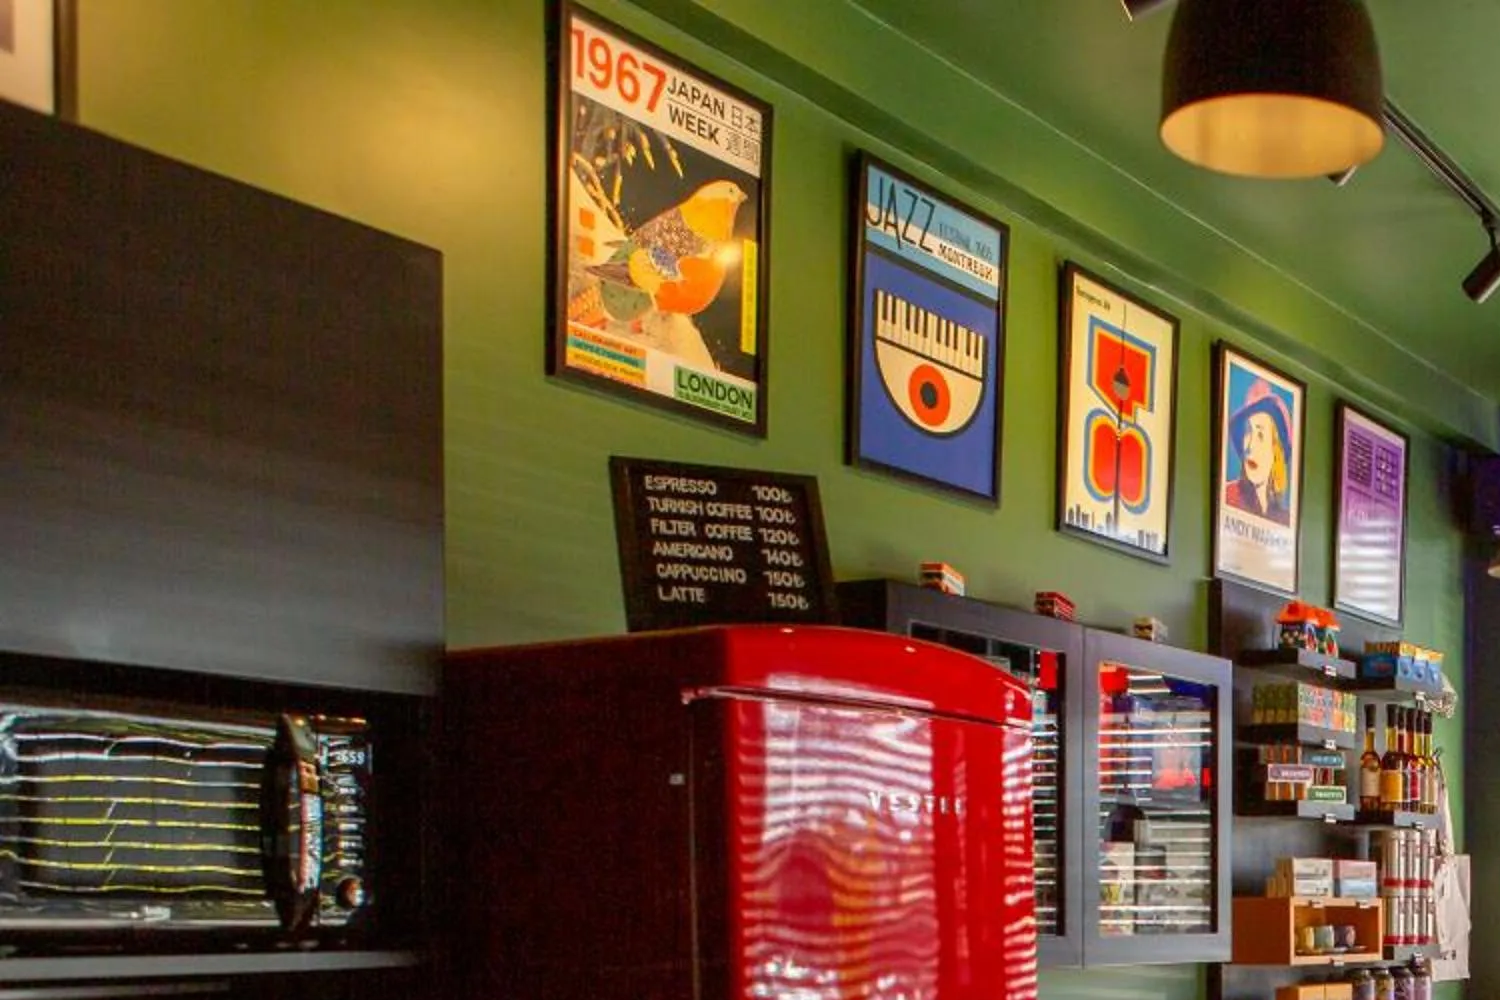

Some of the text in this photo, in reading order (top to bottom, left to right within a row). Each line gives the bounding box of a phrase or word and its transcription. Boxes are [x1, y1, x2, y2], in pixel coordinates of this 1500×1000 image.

[572, 29, 666, 113] 1967
[667, 76, 725, 120] JAPAN
[669, 104, 720, 145] WEEK
[867, 176, 935, 254] JAZZ
[677, 369, 753, 410] LONDON
[645, 475, 717, 496] ESPRESSO
[648, 497, 704, 516] TURKISH
[706, 503, 753, 520] COFFEE
[650, 518, 697, 536] FILTER
[704, 524, 753, 542] COFFEE
[653, 541, 734, 562] AMERICANO
[656, 563, 747, 584] CAPPUCCINO
[658, 584, 705, 603] LATTE
